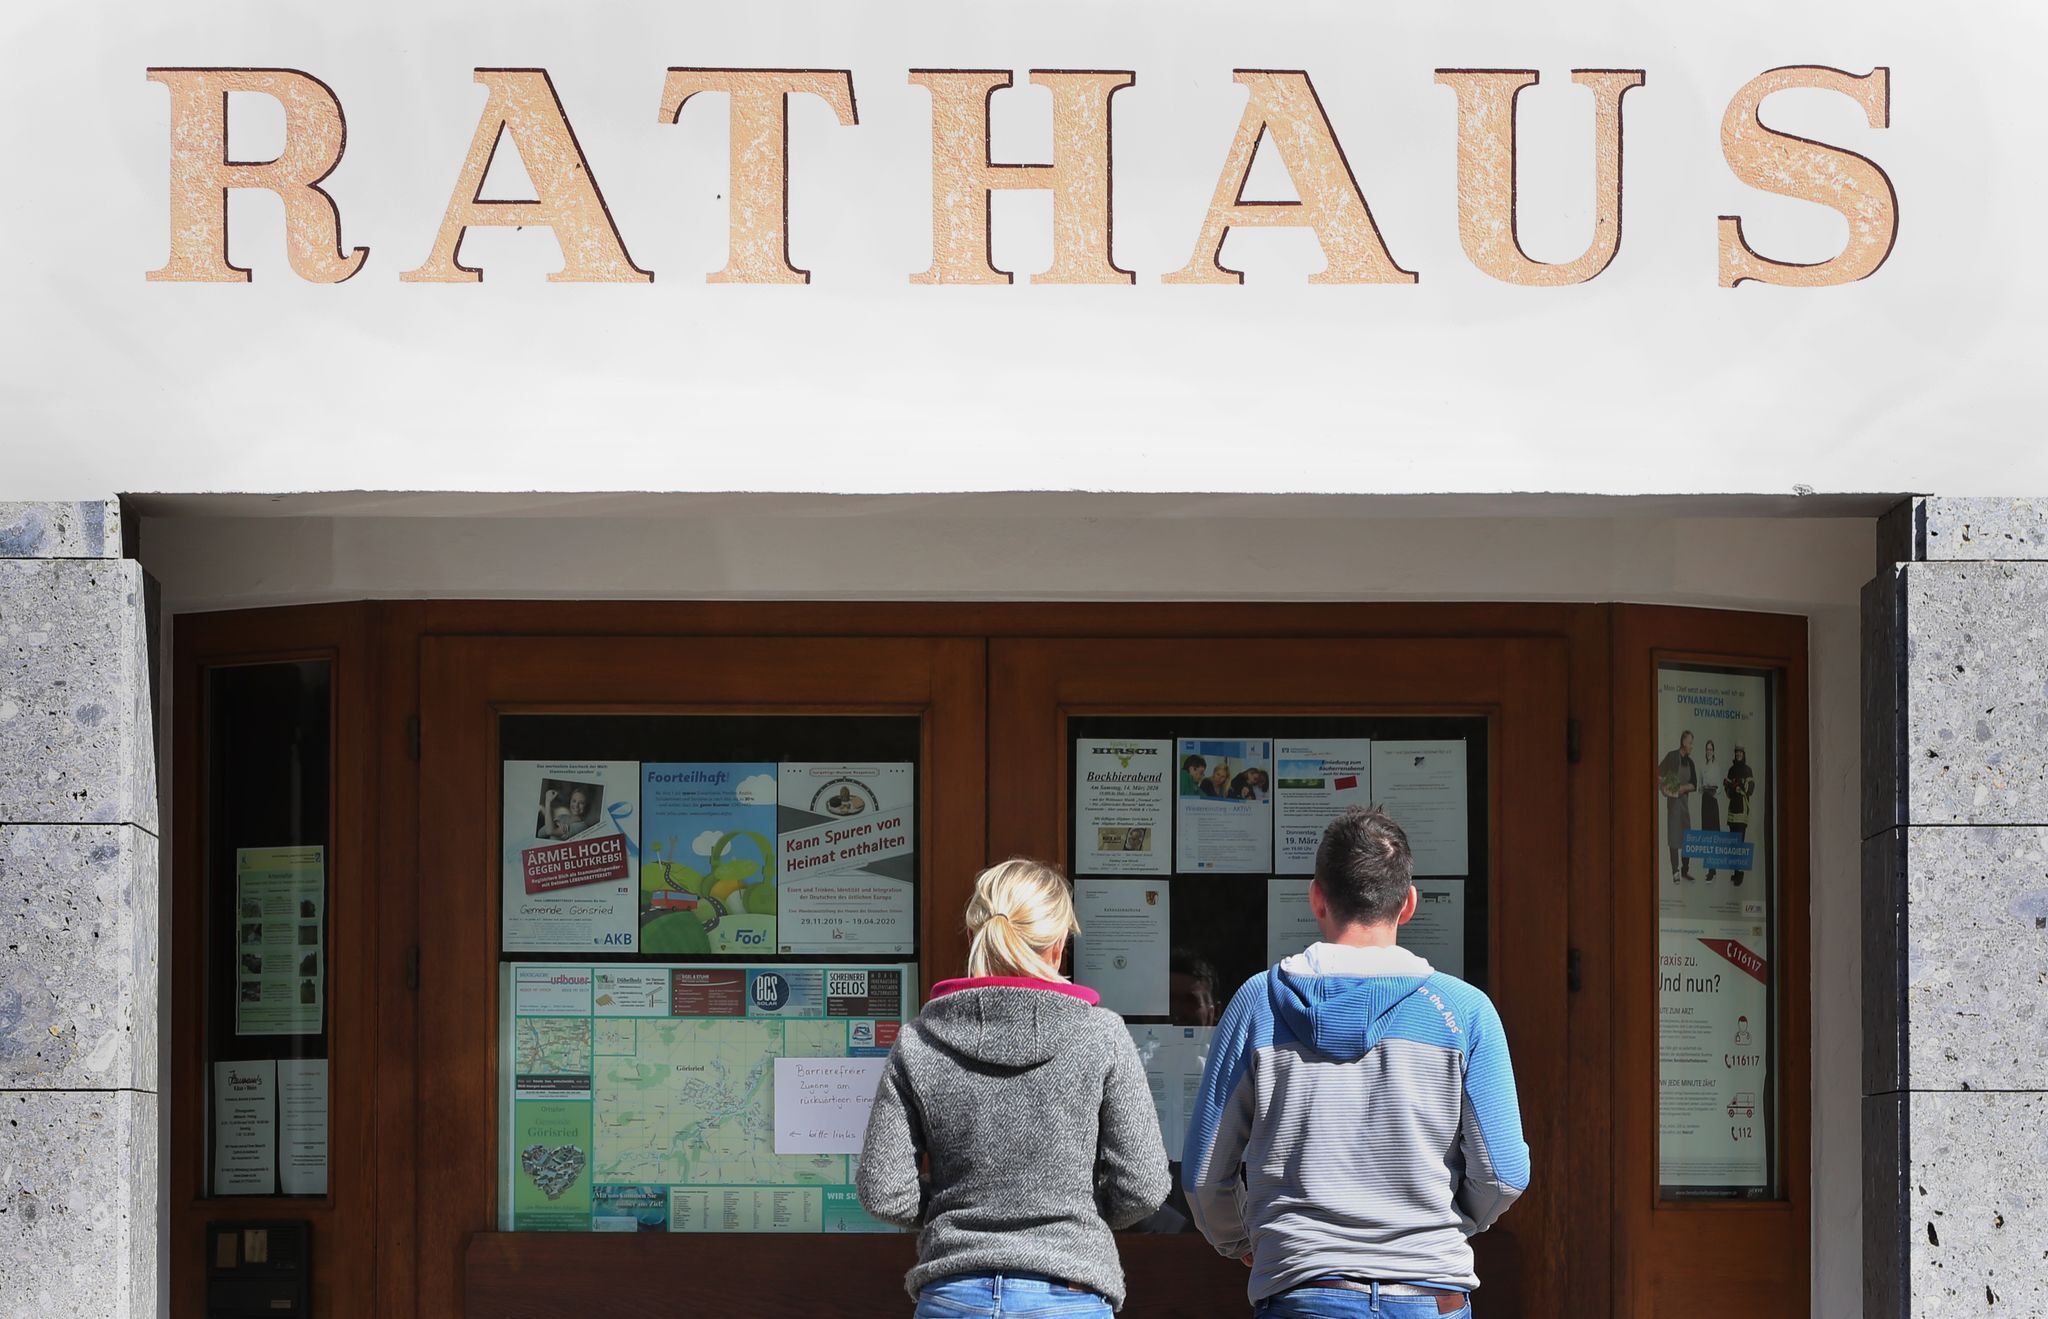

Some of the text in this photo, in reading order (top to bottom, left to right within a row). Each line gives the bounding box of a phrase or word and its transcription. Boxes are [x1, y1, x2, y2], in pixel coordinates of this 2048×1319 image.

[146, 65, 1900, 290] RATHAUS
[1677, 694, 1724, 706] DYNAMISCH
[1695, 707, 1741, 720] DYNAMISCH
[648, 771, 729, 786] Foorteilhaft!
[1087, 771, 1163, 783] Bockbierabend
[787, 817, 901, 852] Kann Spuren von
[527, 839, 621, 867] ÄRMEL HOCH
[787, 836, 905, 872] Heimat enthalten
[1686, 845, 1750, 856] DOPPELT ENGAGIERT
[528, 852, 623, 877] GEGEN BLUTKREBS!
[603, 933, 632, 945] AKB
[735, 929, 766, 944] Foo!
[1660, 953, 1698, 967] raxis zu.
[1733, 947, 1762, 972] 116117
[830, 973, 865, 981] SCHREINEREI
[1686, 974, 1721, 993] nun?
[830, 981, 865, 995] SEELOS
[1417, 985, 1463, 1033] in the Alps.
[1732, 1056, 1760, 1066] 116117
[796, 1064, 867, 1078] Barrierefreier
[800, 1081, 829, 1094] Zugang
[800, 1096, 851, 1110] rückwärtigen
[528, 1127, 579, 1138] Görisried
[809, 1130, 856, 1139] bitte links
[1739, 1127, 1752, 1138] 112
[827, 1192, 844, 1200] WIR
